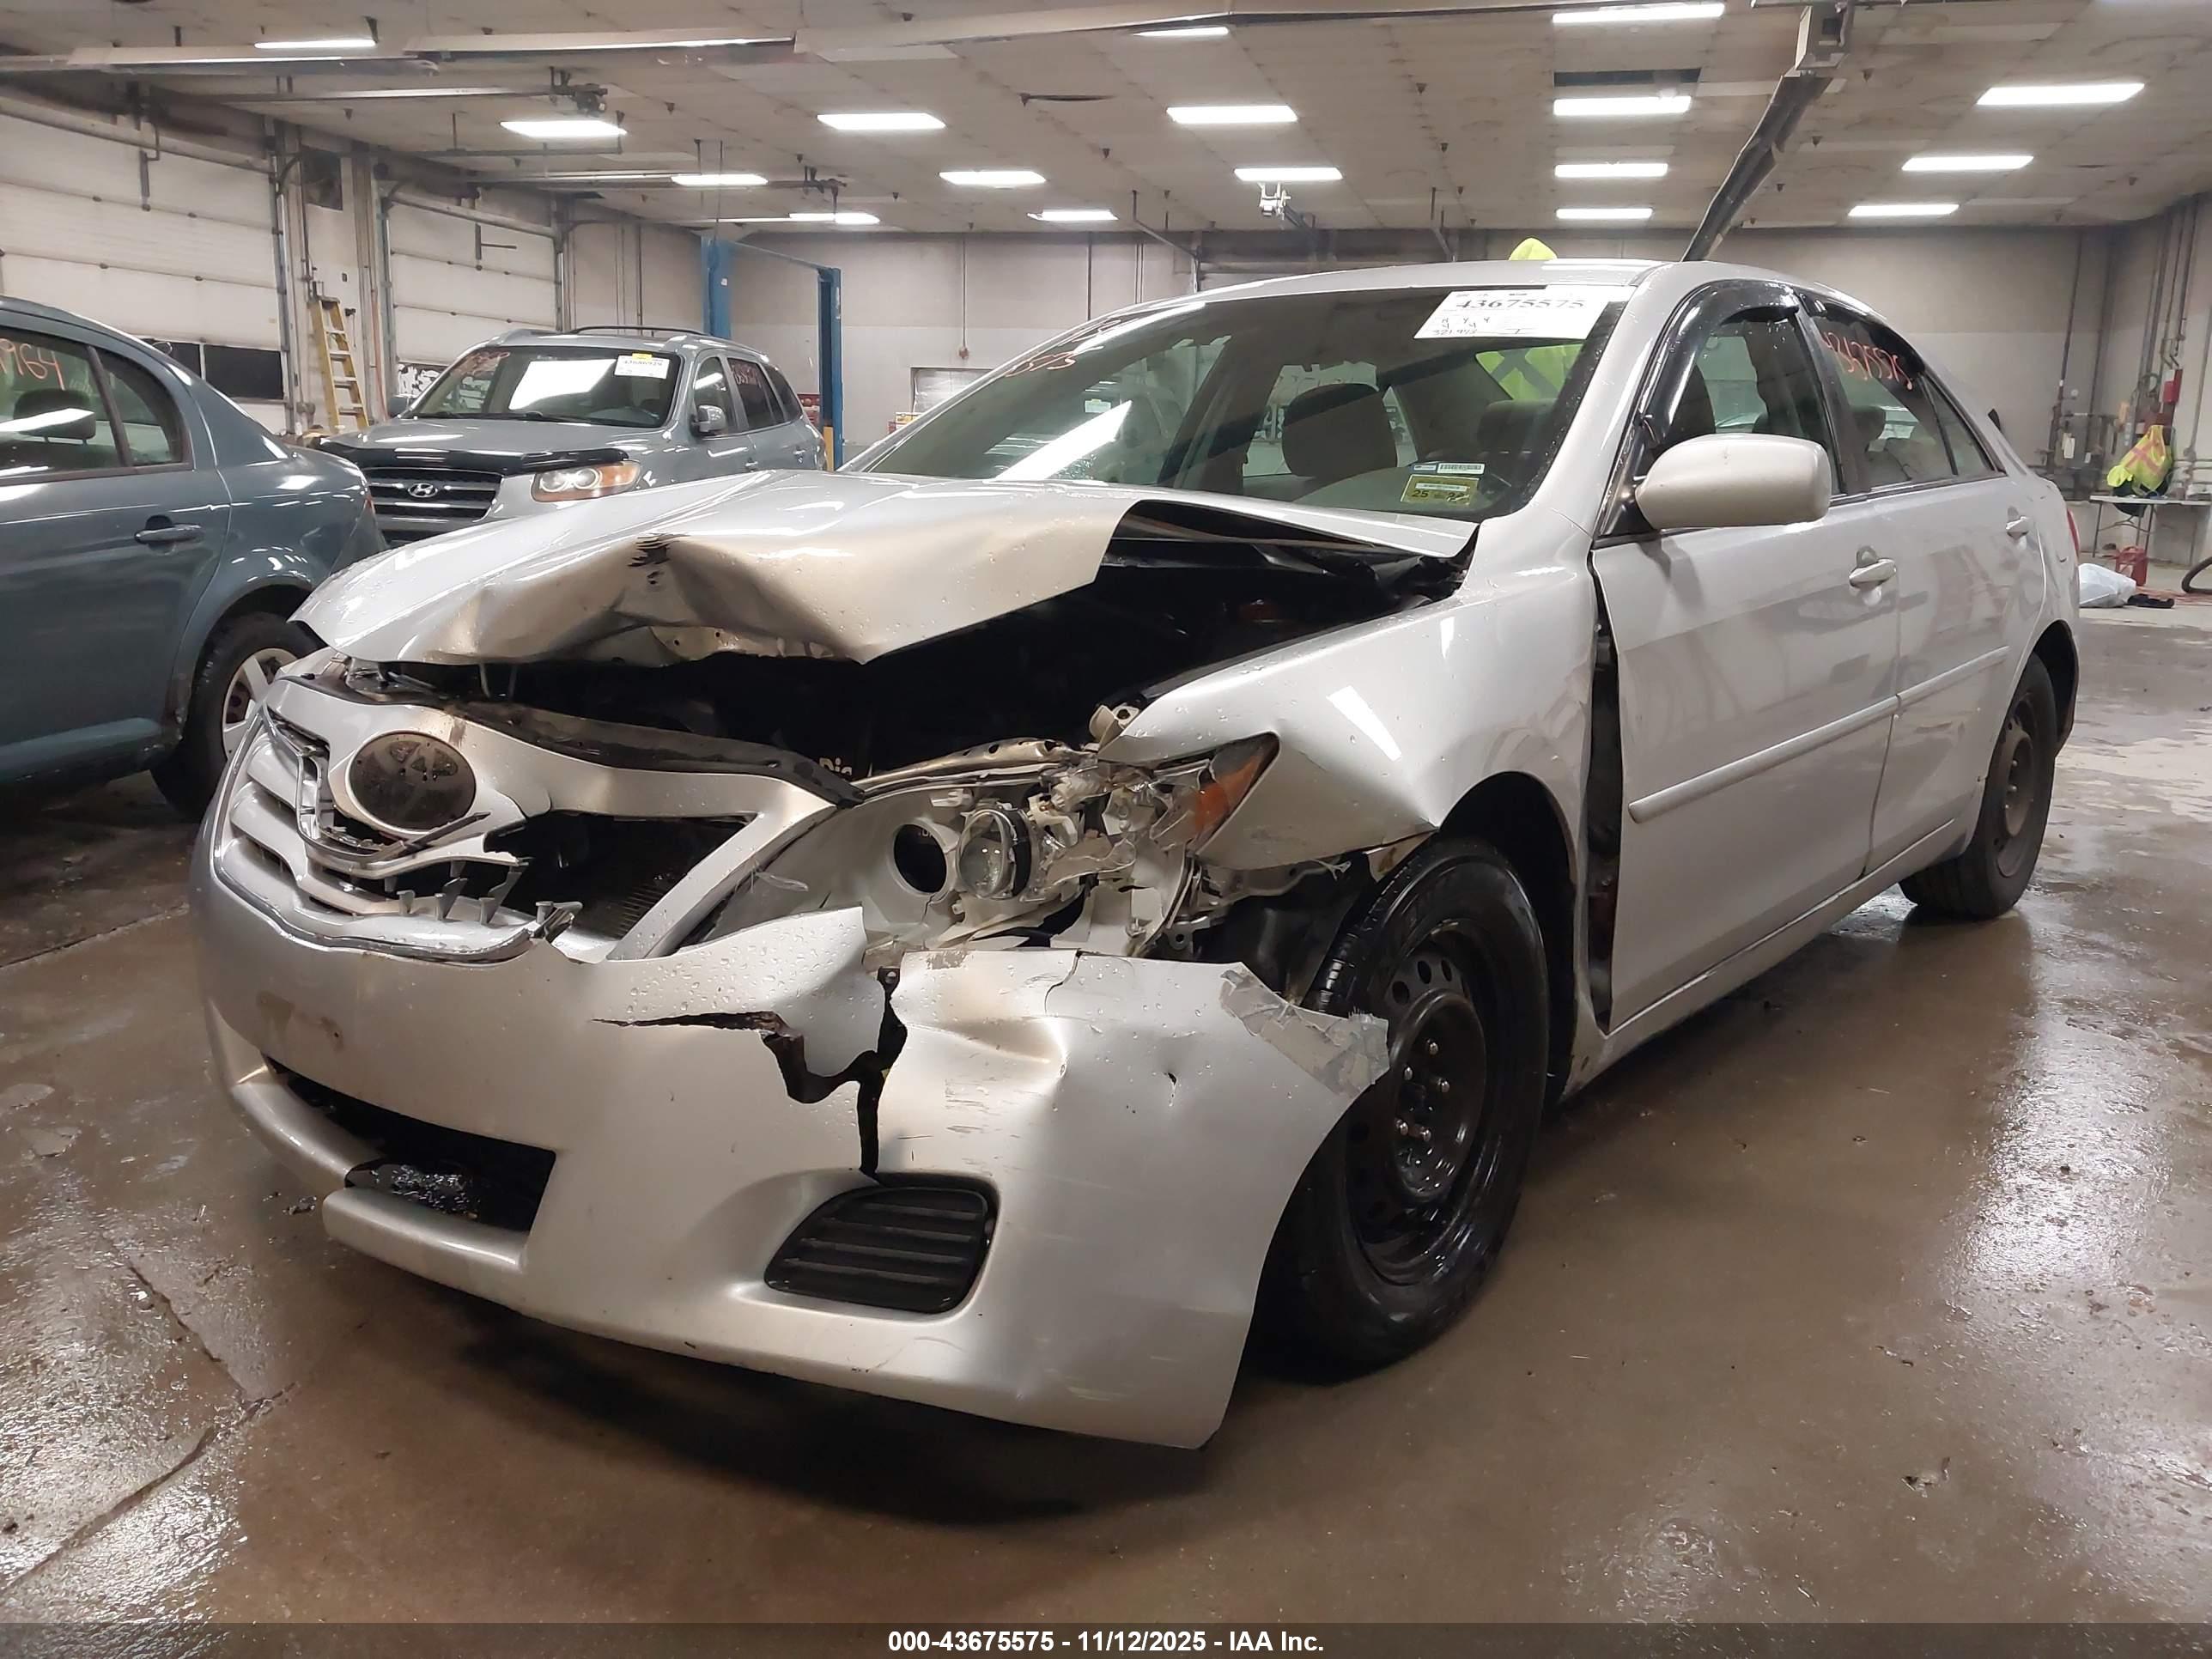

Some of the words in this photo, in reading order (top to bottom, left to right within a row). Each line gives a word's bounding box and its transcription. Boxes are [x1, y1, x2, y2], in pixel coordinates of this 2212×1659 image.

[1455, 300, 1586, 308] 43675575
[0, 337, 65, 391] 964
[1412, 489, 1429, 498] 25
